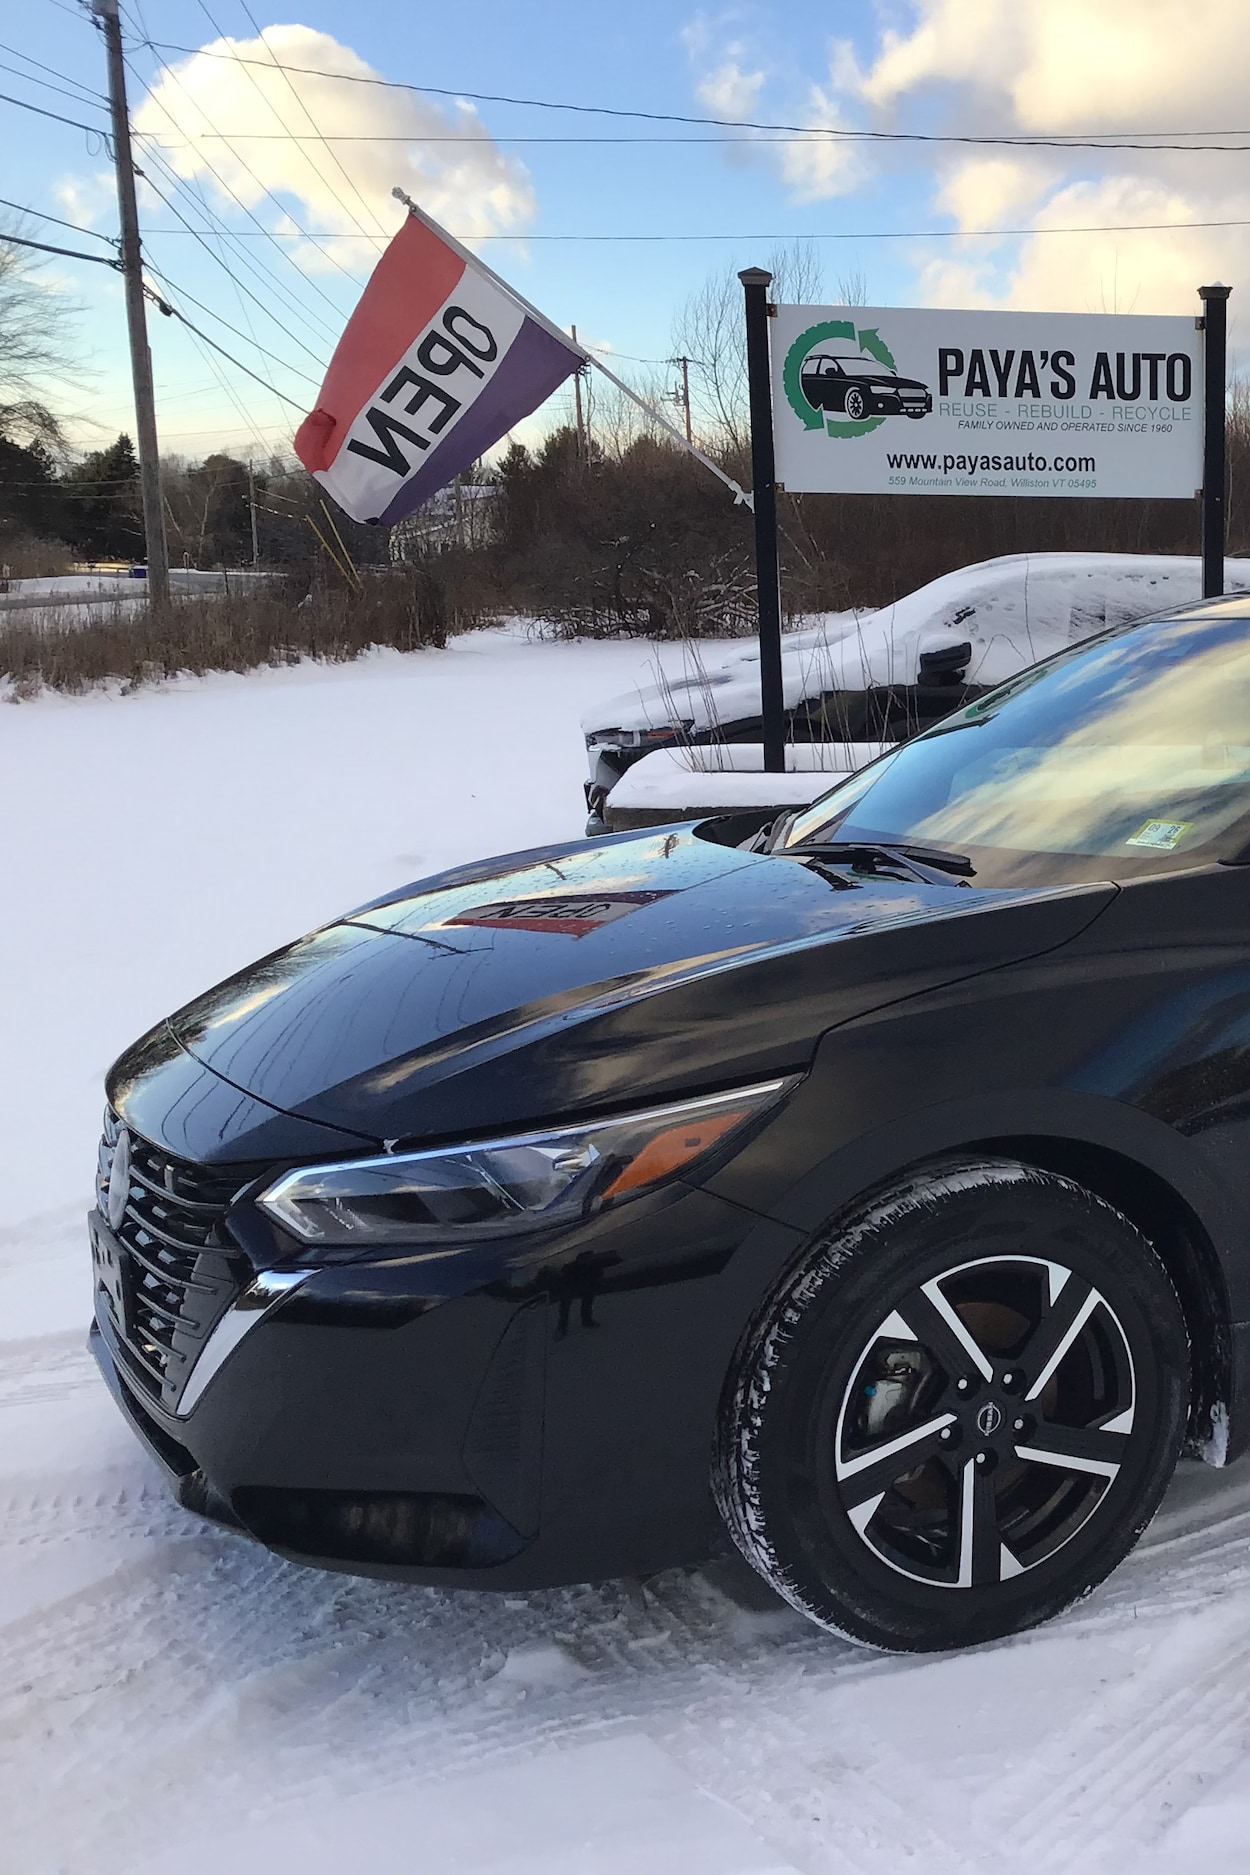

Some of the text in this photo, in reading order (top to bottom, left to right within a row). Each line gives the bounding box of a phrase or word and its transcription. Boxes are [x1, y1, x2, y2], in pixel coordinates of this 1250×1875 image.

[938, 348, 1191, 402] PAYA'S AUTO
[939, 402, 998, 418] REUSE
[1018, 404, 1092, 419] REBUILD
[1112, 405, 1192, 421] RECYCLE
[957, 420, 1173, 433] FAMILY OWNED AND OPERATED SINCE 1960
[886, 452, 1096, 475] www.payasauto.com
[888, 476, 1097, 489] 559 Mountain View Road, Williston VT 05495
